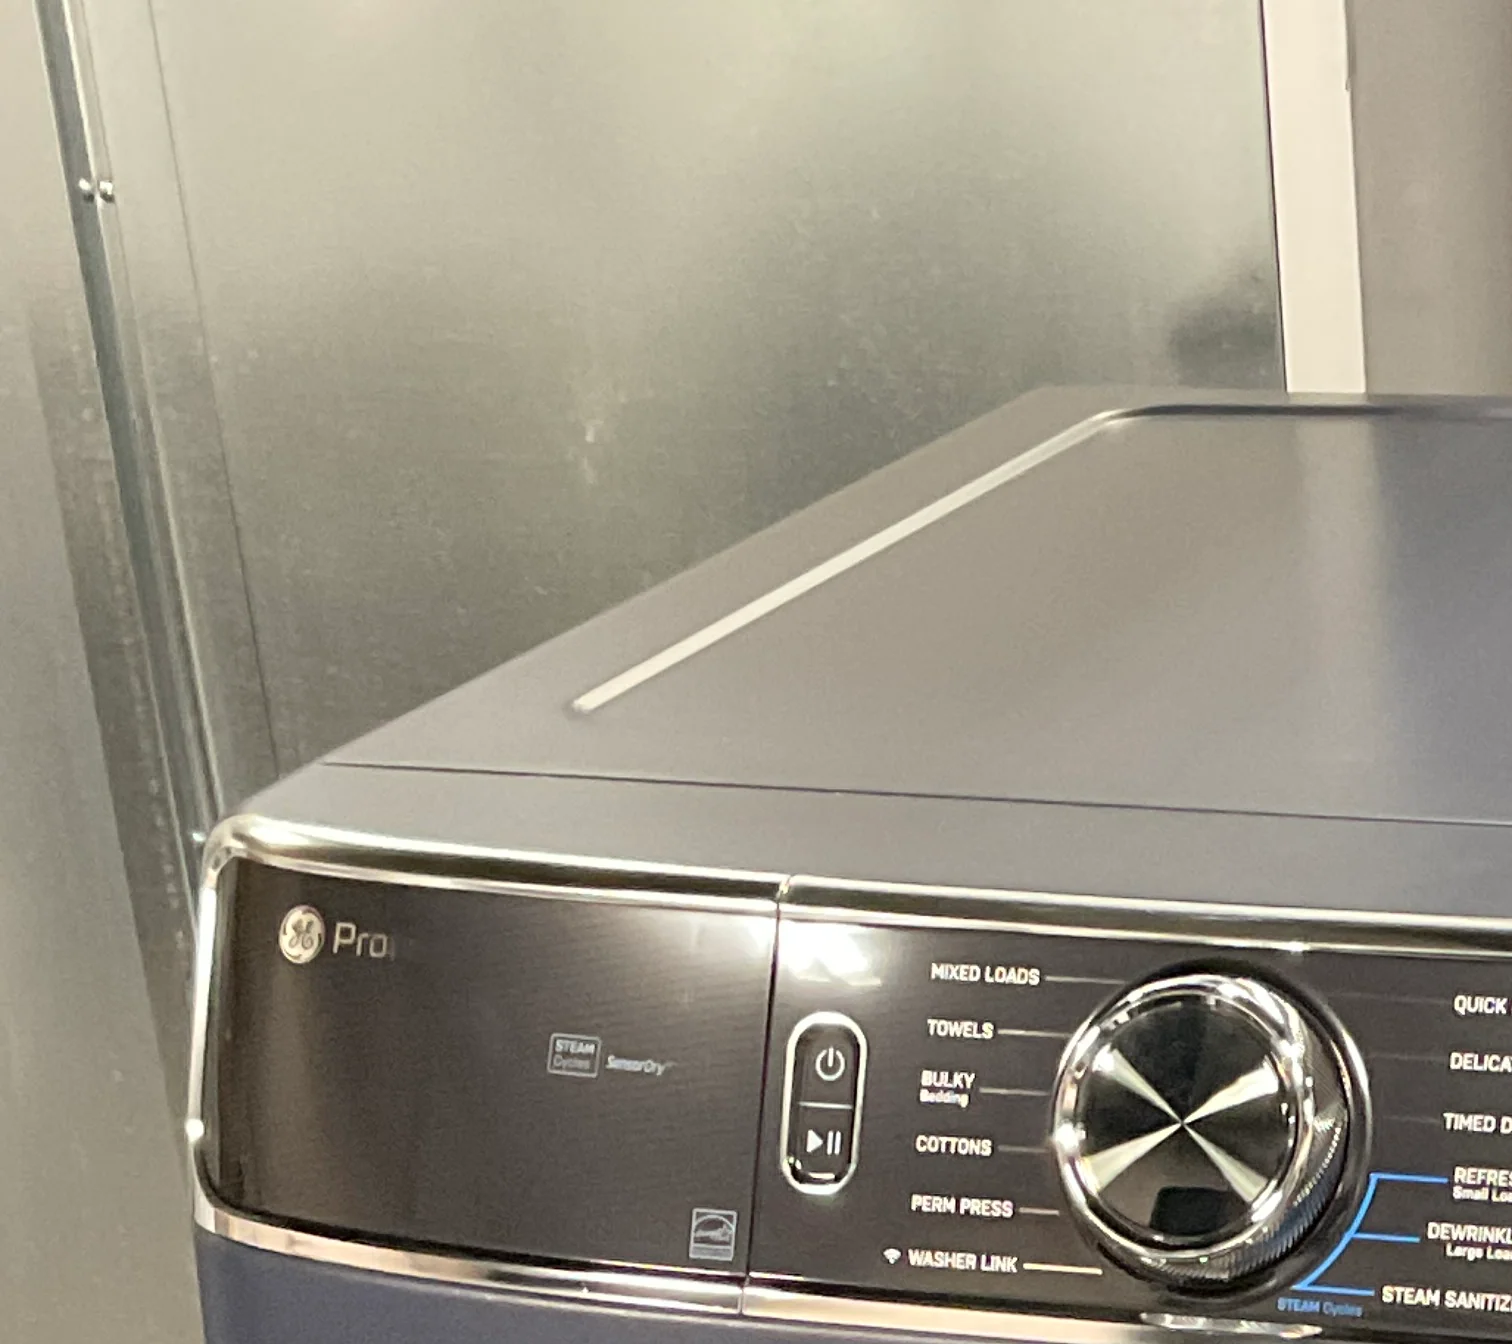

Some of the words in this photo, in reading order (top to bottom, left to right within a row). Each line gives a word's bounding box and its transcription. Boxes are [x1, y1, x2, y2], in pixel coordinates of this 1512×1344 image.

[931, 962, 980, 982] MIXED
[985, 965, 1040, 985] LOADS
[1453, 994, 1507, 1016] QUICK
[927, 1018, 994, 1040] TOWELS
[921, 1070, 976, 1090] BULKY
[1443, 1111, 1497, 1134] TIMED
[915, 1135, 992, 1157] COTTONS
[1452, 1187, 1491, 1203] Small
[911, 1195, 956, 1215] PERM
[959, 1197, 1014, 1218] PRESS
[907, 1248, 978, 1271] WASHER
[980, 1252, 1018, 1273] LINK
[1445, 1244, 1485, 1262] Large
[1277, 1296, 1320, 1313] STEAM
[1381, 1285, 1441, 1308] STEAM
